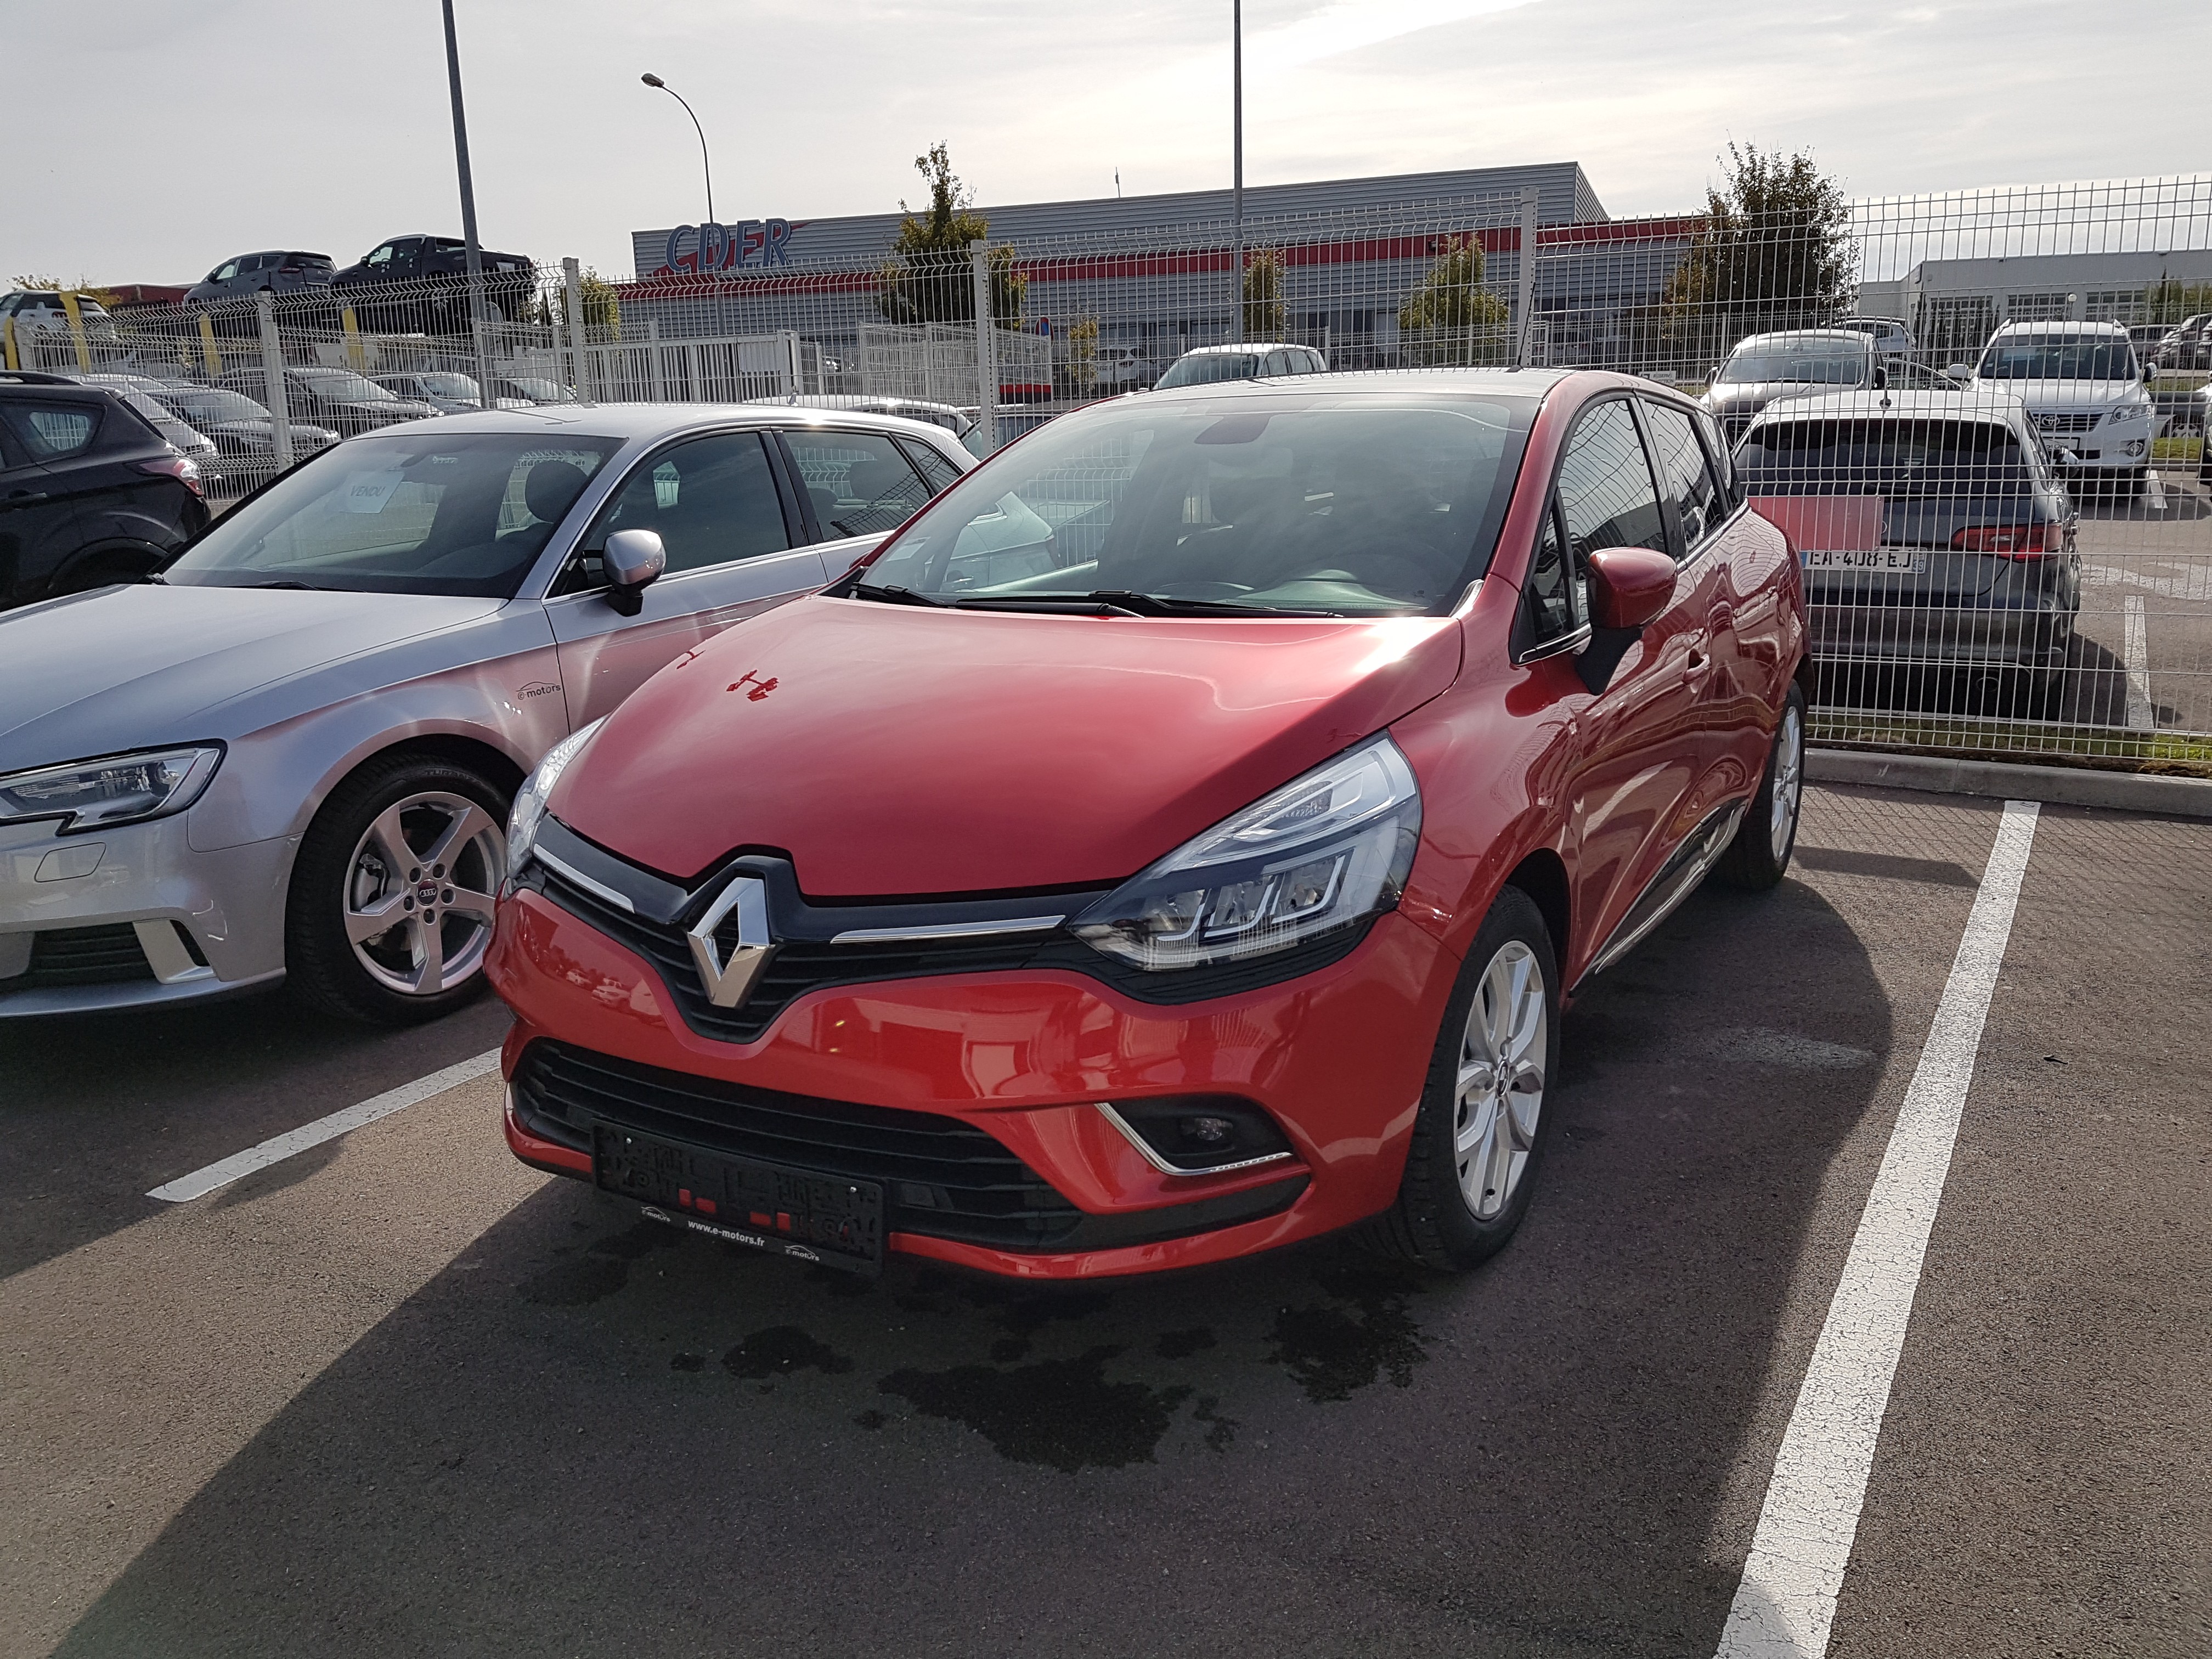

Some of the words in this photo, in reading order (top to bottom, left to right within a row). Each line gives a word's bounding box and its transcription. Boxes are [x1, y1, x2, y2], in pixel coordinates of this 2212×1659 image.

[666, 218, 791, 273] CDER
[351, 486, 386, 496] VENDU
[688, 1221, 765, 1246] www.e-motors.fr
